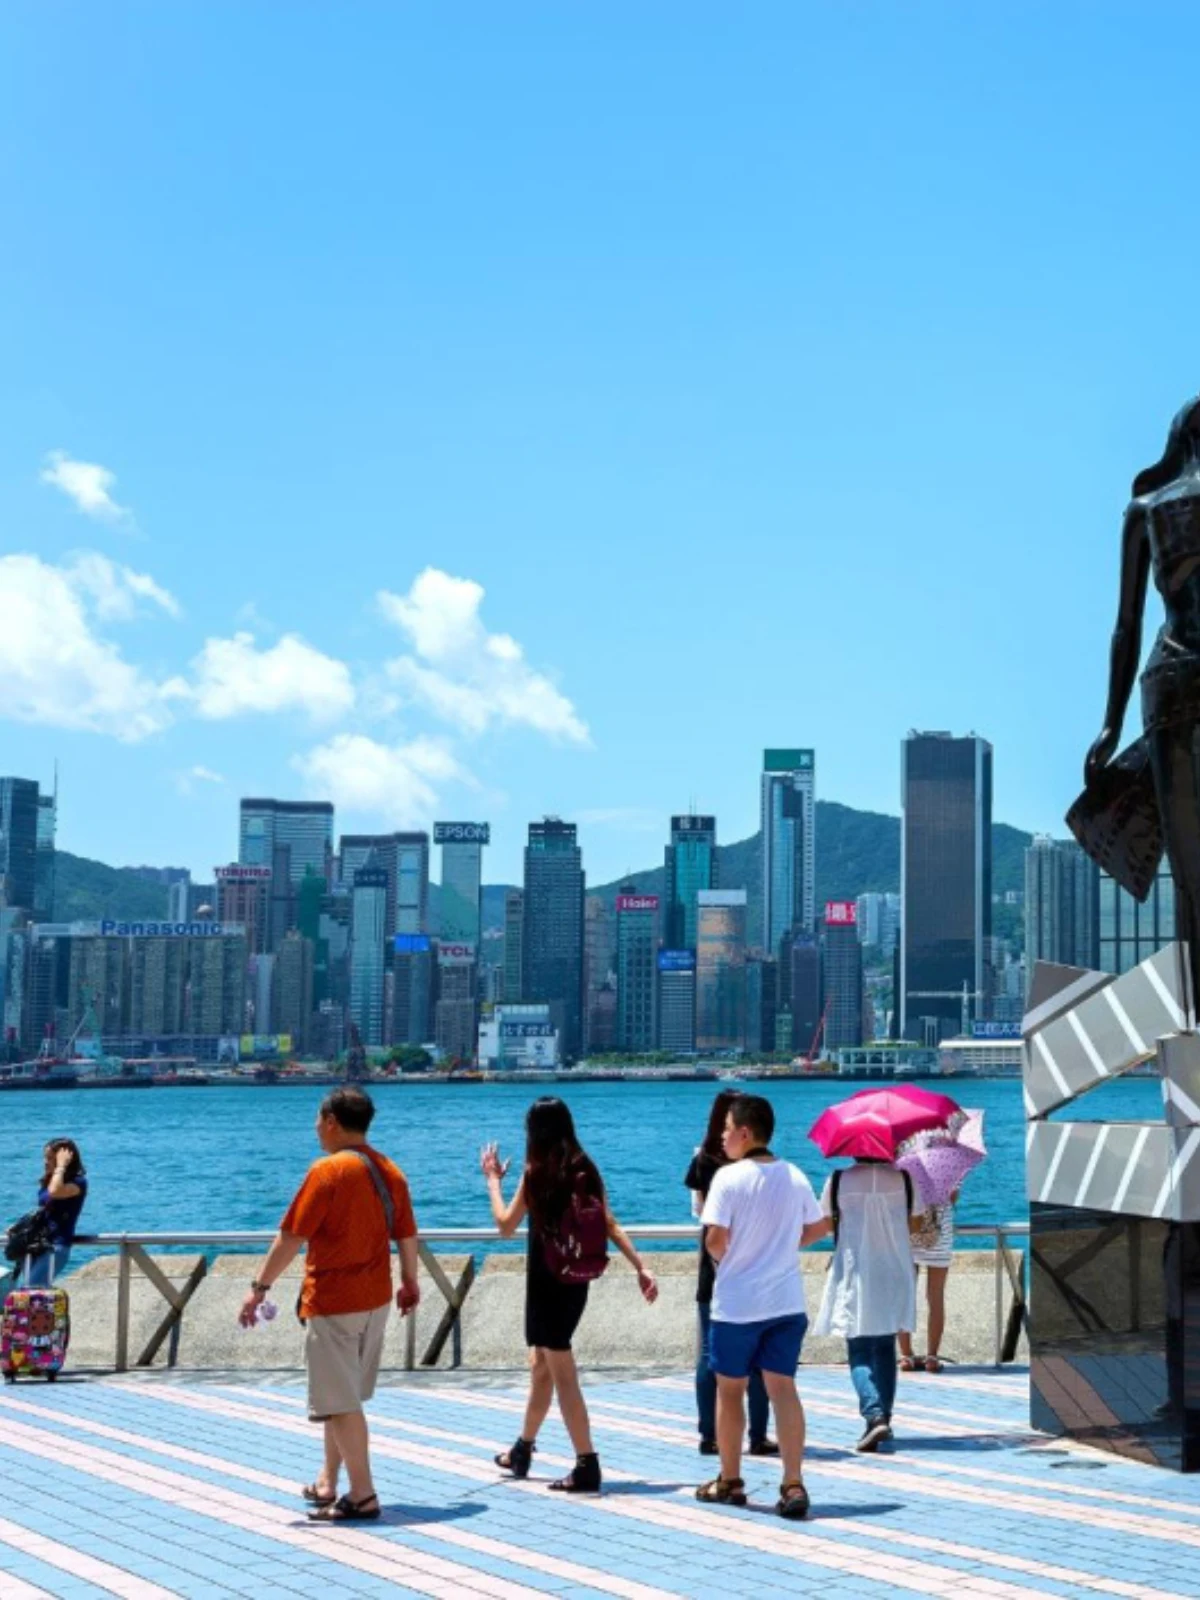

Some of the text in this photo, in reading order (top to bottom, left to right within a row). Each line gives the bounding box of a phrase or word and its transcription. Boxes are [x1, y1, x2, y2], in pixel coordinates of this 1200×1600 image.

[435, 826, 486, 838] EPSON
[101, 920, 223, 935] Panasonic
[440, 945, 473, 957] TCL
